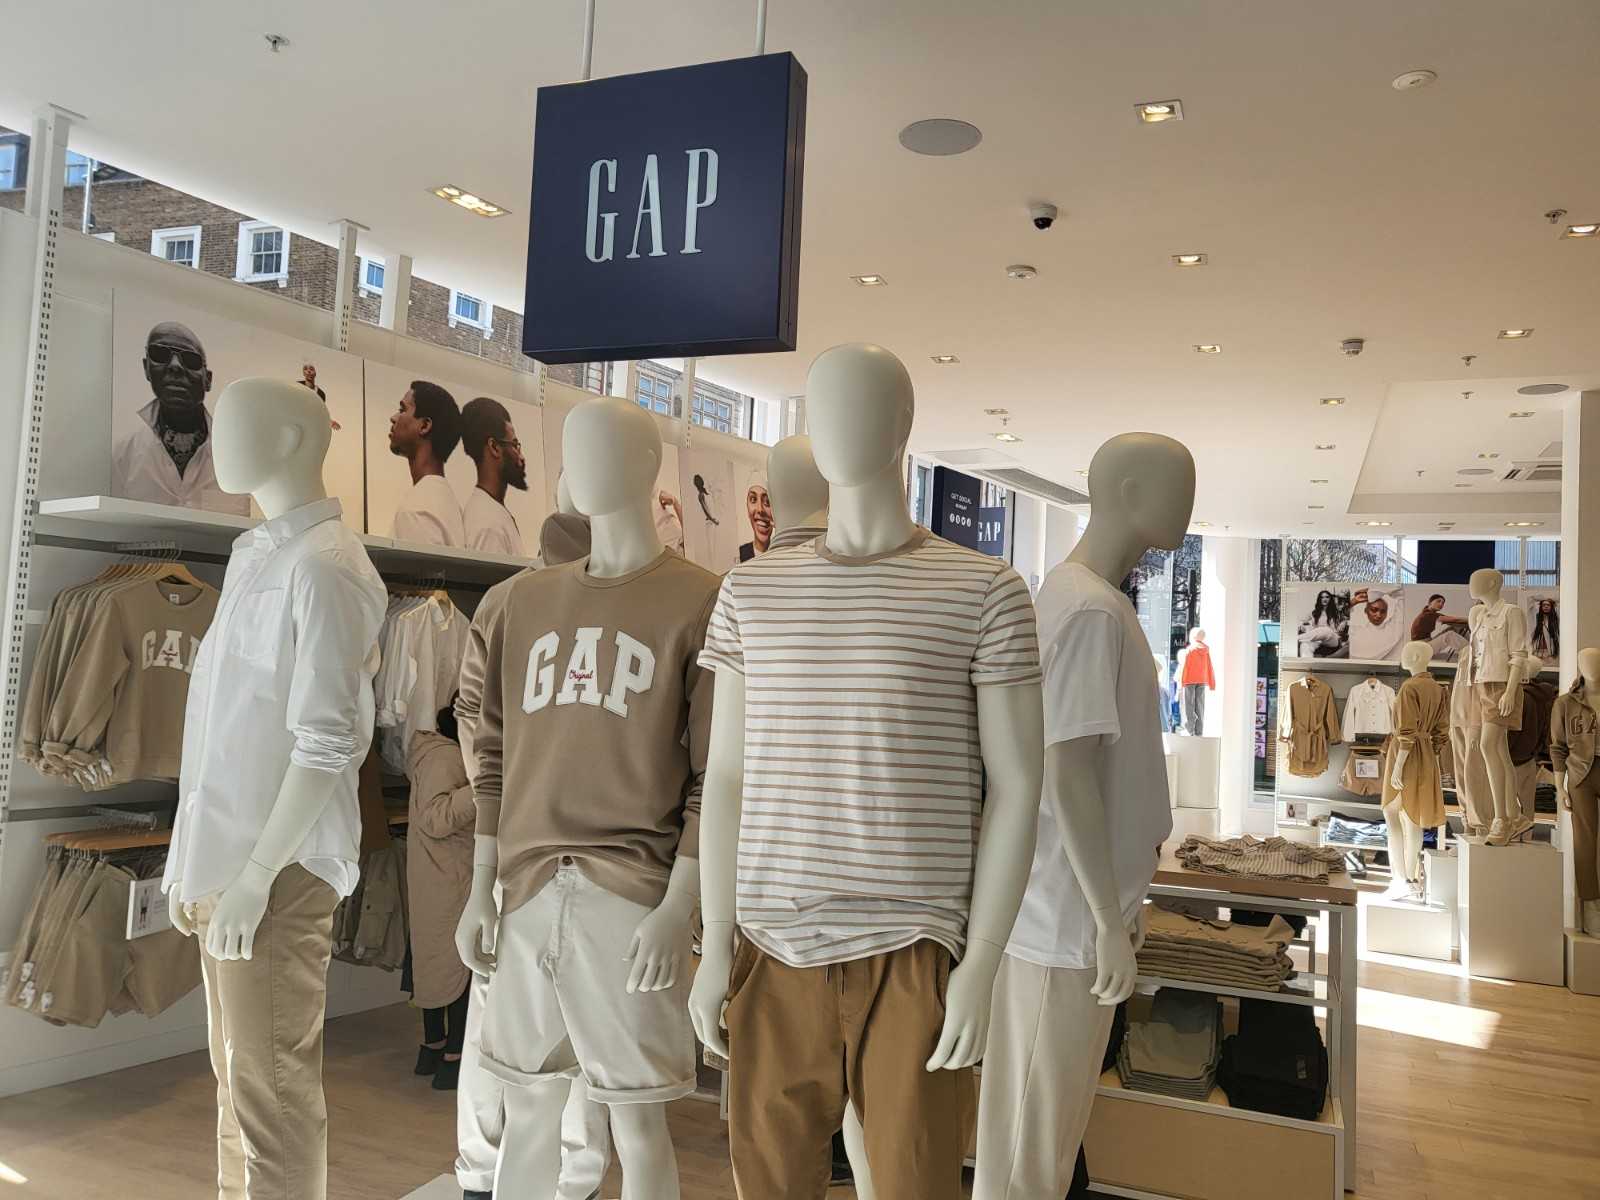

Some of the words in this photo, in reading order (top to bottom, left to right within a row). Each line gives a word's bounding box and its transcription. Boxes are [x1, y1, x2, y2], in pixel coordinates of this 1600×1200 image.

[585, 148, 719, 263] GAP
[521, 627, 656, 718] GAP
[568, 669, 594, 681] Original
